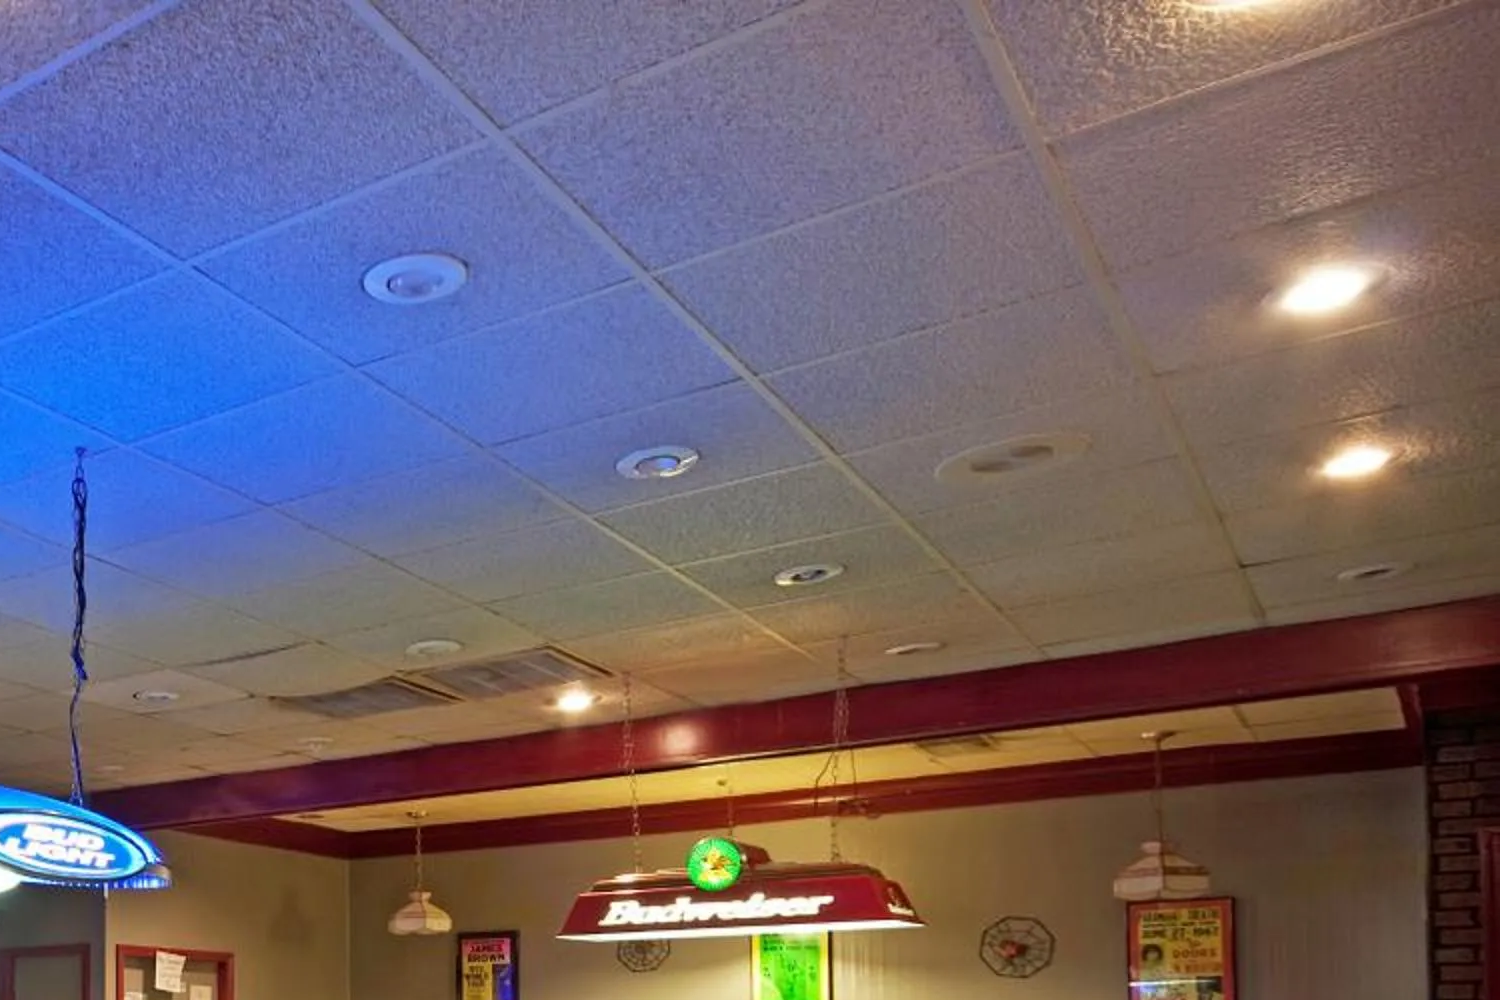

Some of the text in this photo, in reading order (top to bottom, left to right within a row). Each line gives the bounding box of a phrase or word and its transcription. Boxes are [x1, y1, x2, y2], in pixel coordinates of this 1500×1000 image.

[22, 823, 105, 852] BUD
[0, 837, 116, 869] LIGHT
[597, 892, 835, 927] Budweiser
[466, 952, 506, 963] BROWN
[469, 942, 504, 953] JAMES
[1172, 947, 1217, 959] DOORS
